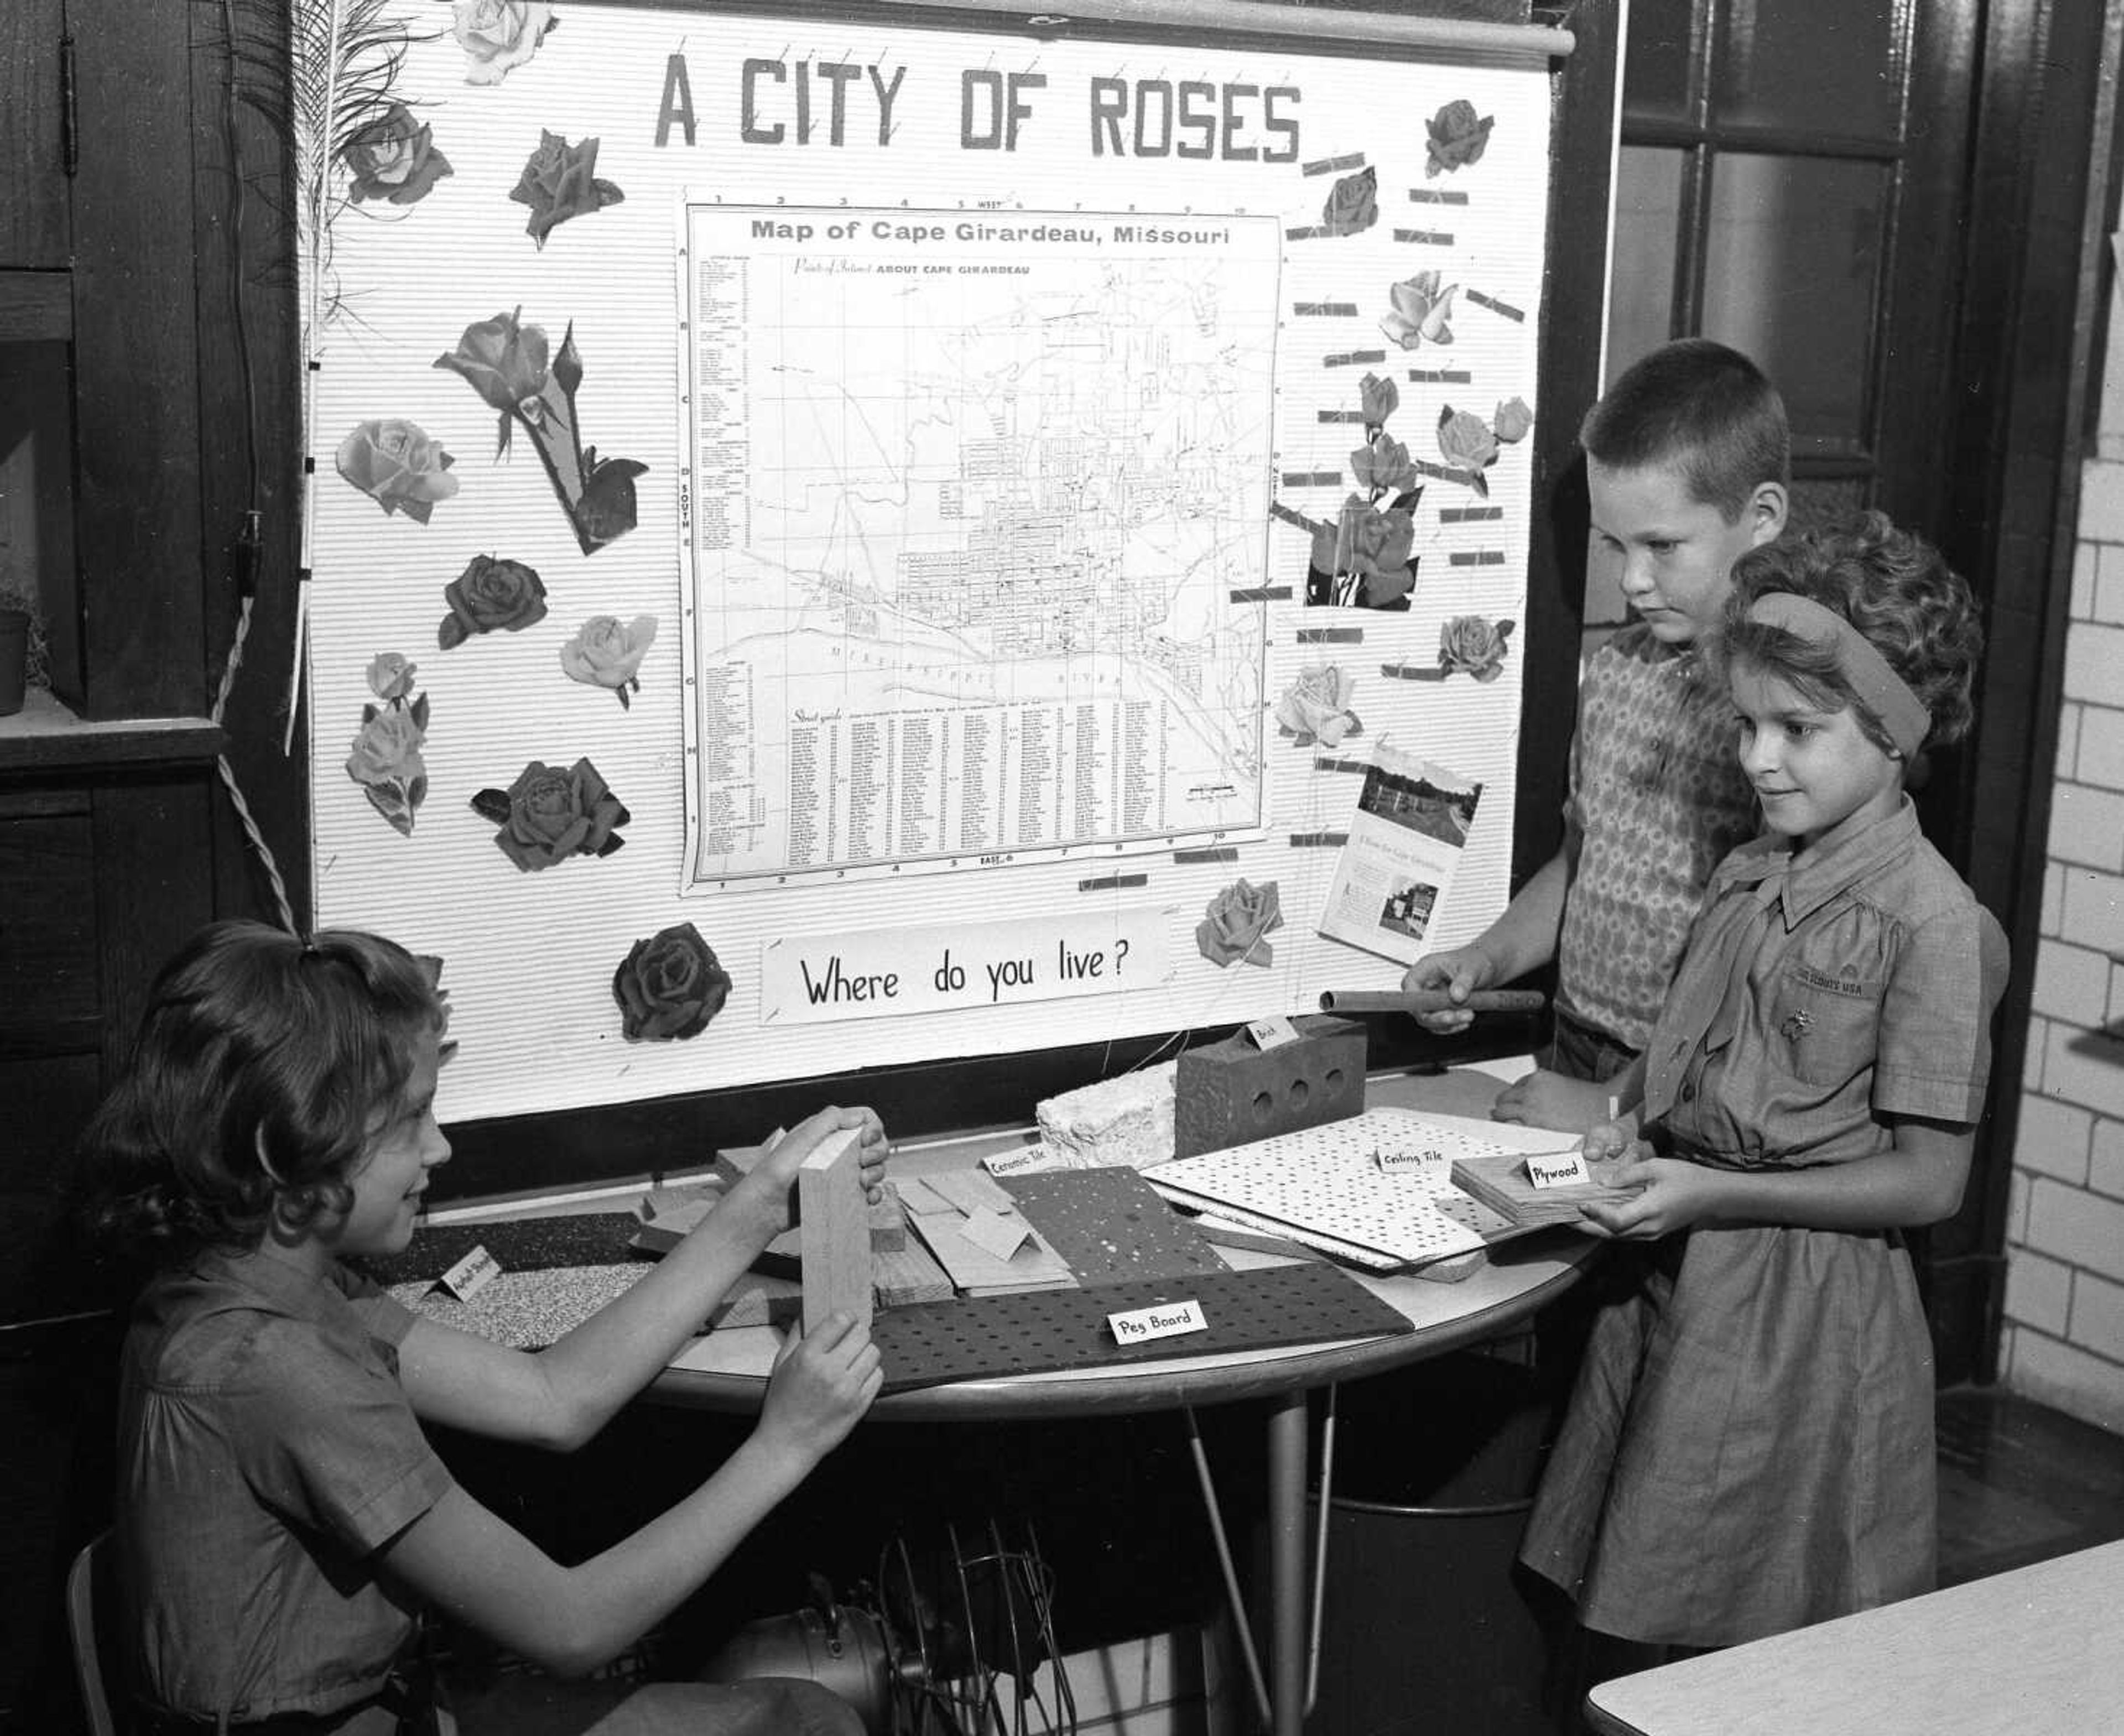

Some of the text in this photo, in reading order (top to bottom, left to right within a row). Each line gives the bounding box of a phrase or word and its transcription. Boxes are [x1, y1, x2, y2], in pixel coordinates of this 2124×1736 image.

[655, 54, 1301, 164] A CITY OF ROSES
[777, 196, 784, 205] 2
[752, 221, 1229, 246] Map of Cape Girardeau, Missouri
[877, 265, 918, 274] ABOUT
[923, 265, 952, 274] CAPE
[959, 266, 1030, 275] GIRARDEAU
[800, 956, 898, 1005] Where
[935, 948, 965, 992] do
[987, 958, 1033, 1002] you
[1842, 983, 1862, 995] USA
[1533, 1161, 1579, 1183] Plywood
[1118, 1308, 1191, 1335] Peg Board
